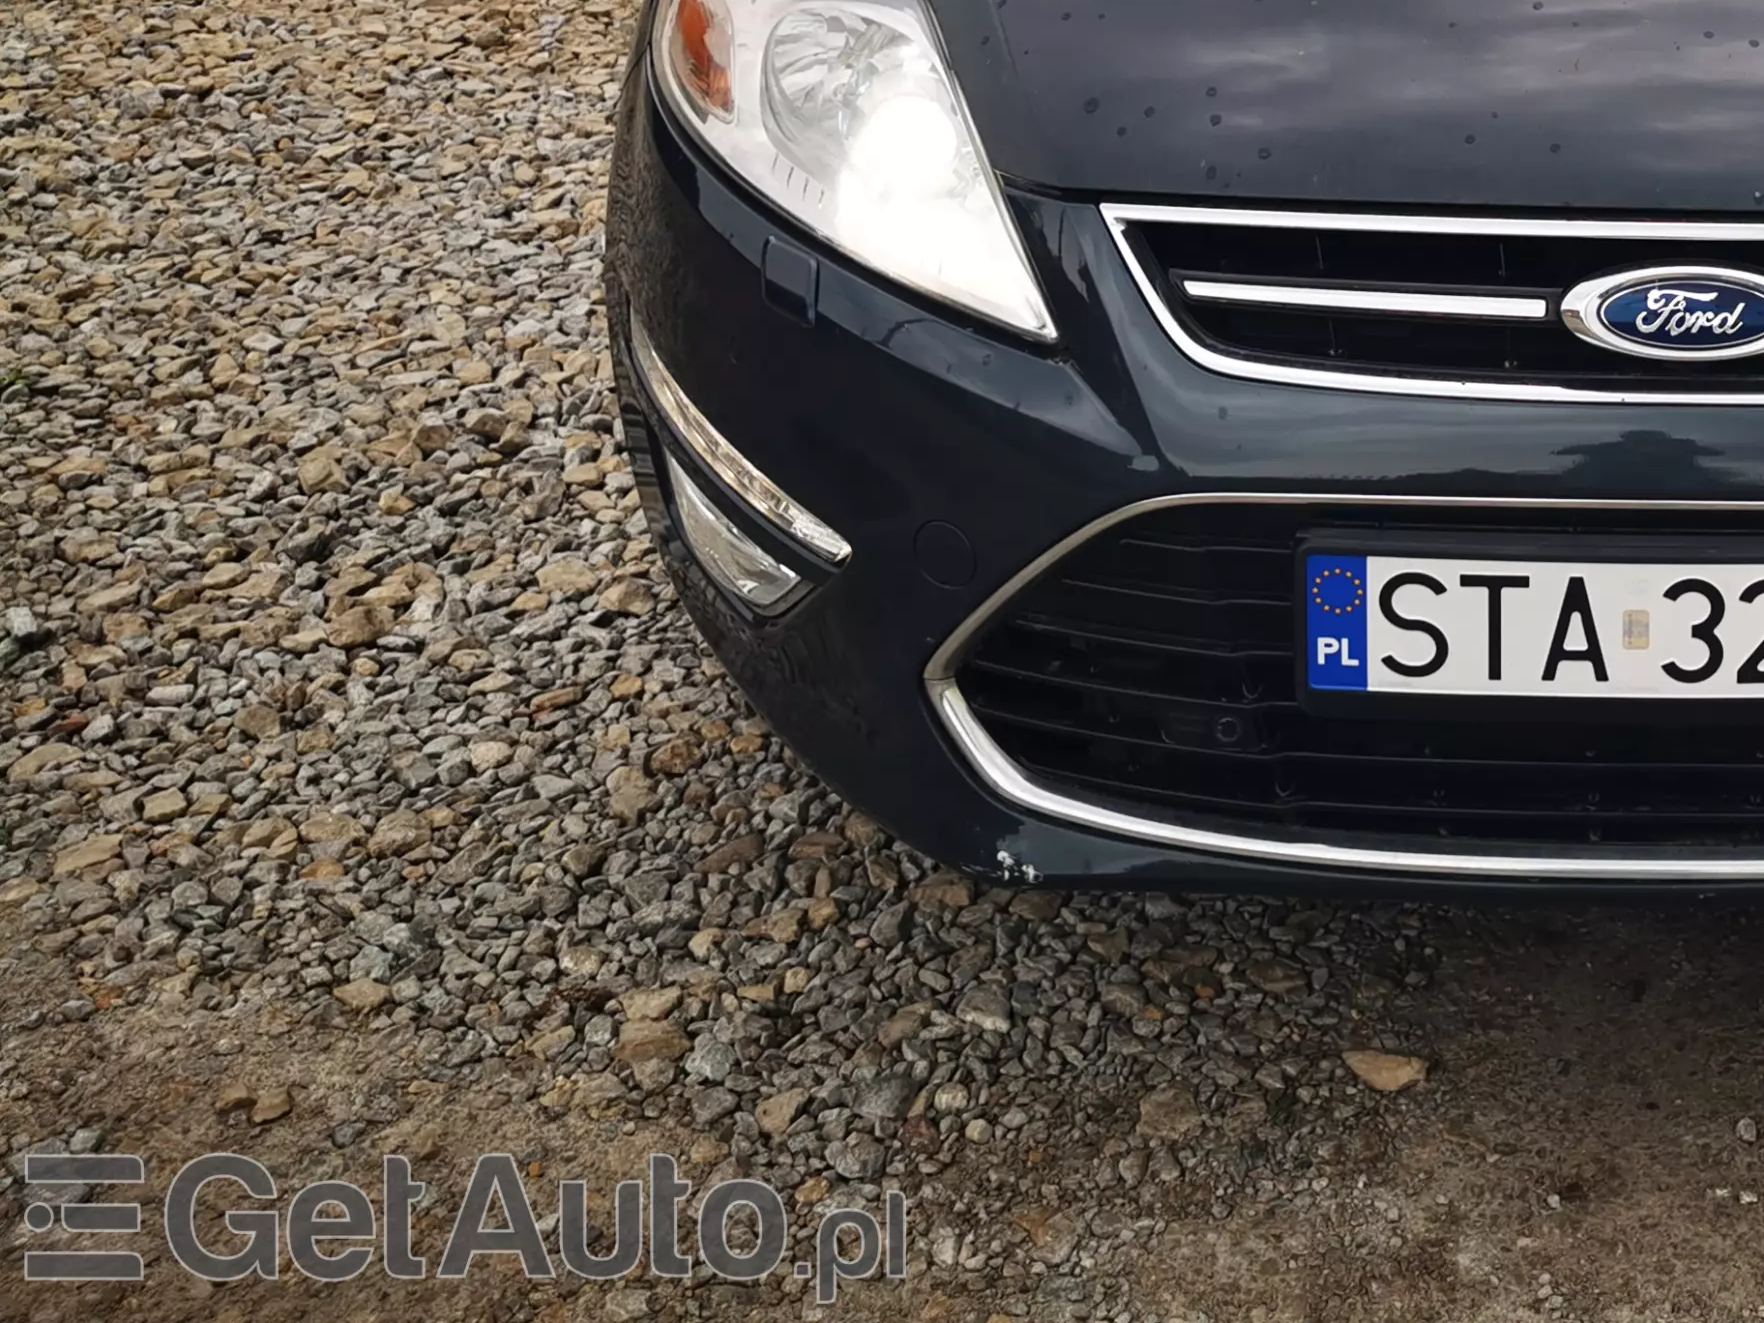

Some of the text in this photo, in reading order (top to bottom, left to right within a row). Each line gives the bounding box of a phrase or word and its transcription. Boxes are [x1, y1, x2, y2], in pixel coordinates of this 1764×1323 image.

[1634, 288, 1746, 337] Ford
[1317, 637, 1360, 667] PL
[1378, 571, 1610, 683] STA
